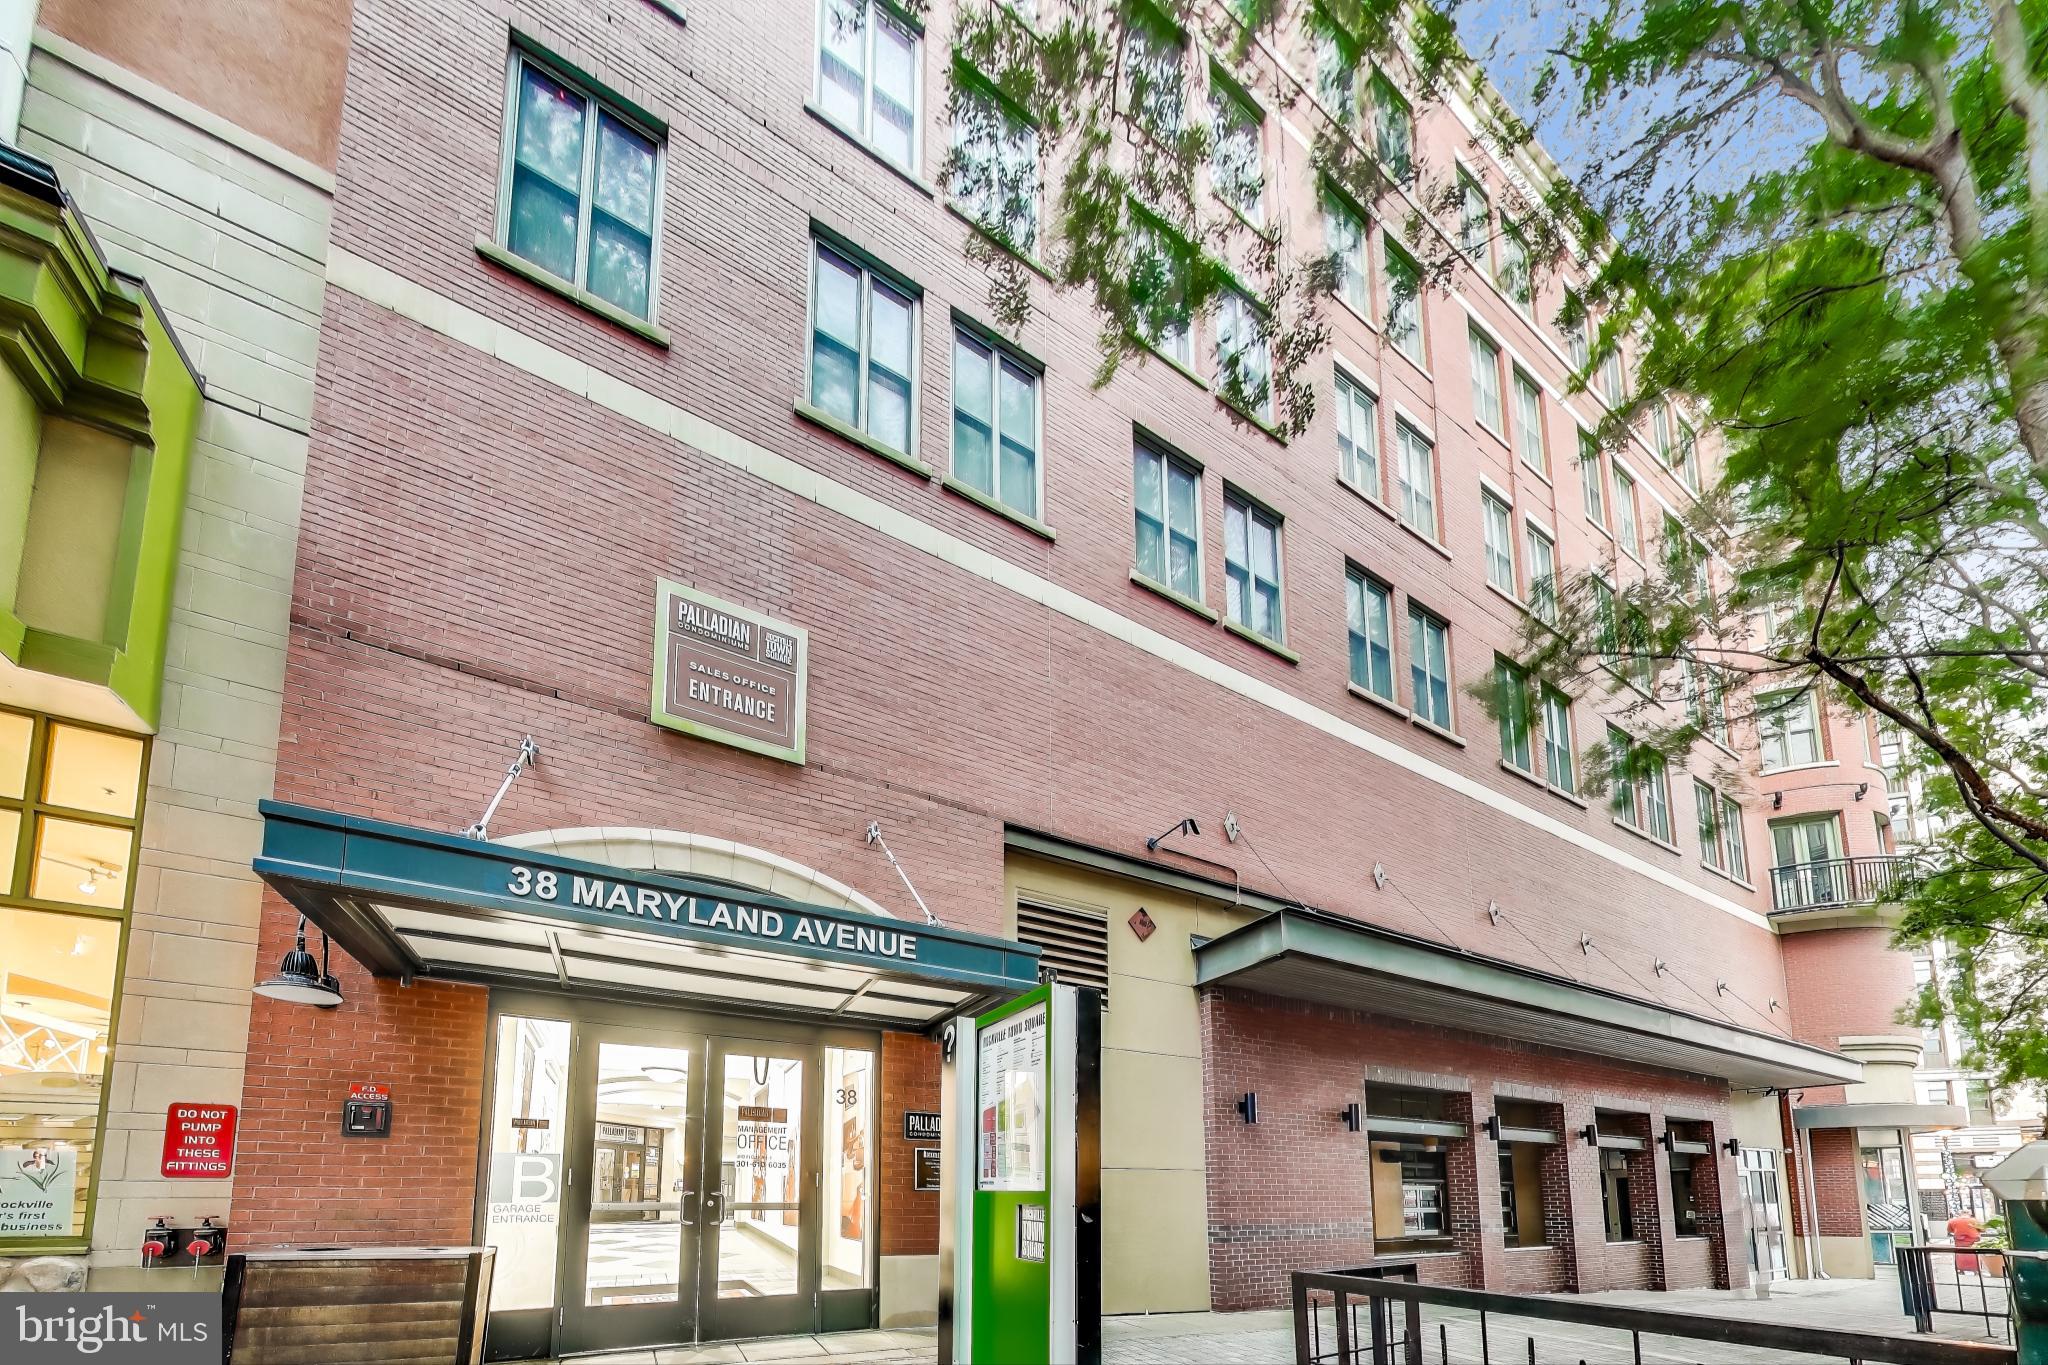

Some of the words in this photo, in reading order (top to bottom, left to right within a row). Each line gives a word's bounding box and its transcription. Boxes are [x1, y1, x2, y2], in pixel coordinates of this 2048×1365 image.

[678, 601, 750, 643] PALLADIAN
[766, 640, 793, 659] TOWN
[689, 661, 730, 681] SALES
[733, 675, 776, 696] OFFICE
[689, 678, 775, 723] ENTRANCE
[507, 866, 558, 900] 38
[572, 877, 785, 938] MARYLAND
[792, 917, 918, 960] AVENUE
[1025, 1012, 1046, 1032] SQUARE
[350, 1093, 389, 1101] ACCESS
[836, 1089, 857, 1105] 38
[178, 1109, 198, 1118] DO
[200, 1110, 228, 1119] NOT
[181, 1122, 222, 1132] PUMP
[738, 1125, 787, 1135] MANAGEMENT
[184, 1135, 216, 1145] INTO
[738, 1134, 787, 1150] OFFICE
[177, 1148, 220, 1158] THESE
[166, 1161, 227, 1171] FITTINGS
[511, 1155, 556, 1204] B
[493, 1204, 542, 1213] GARAGE
[19, 1212, 46, 1220] first
[492, 1214, 555, 1224] ENTRANCE
[1, 1223, 63, 1231] business
